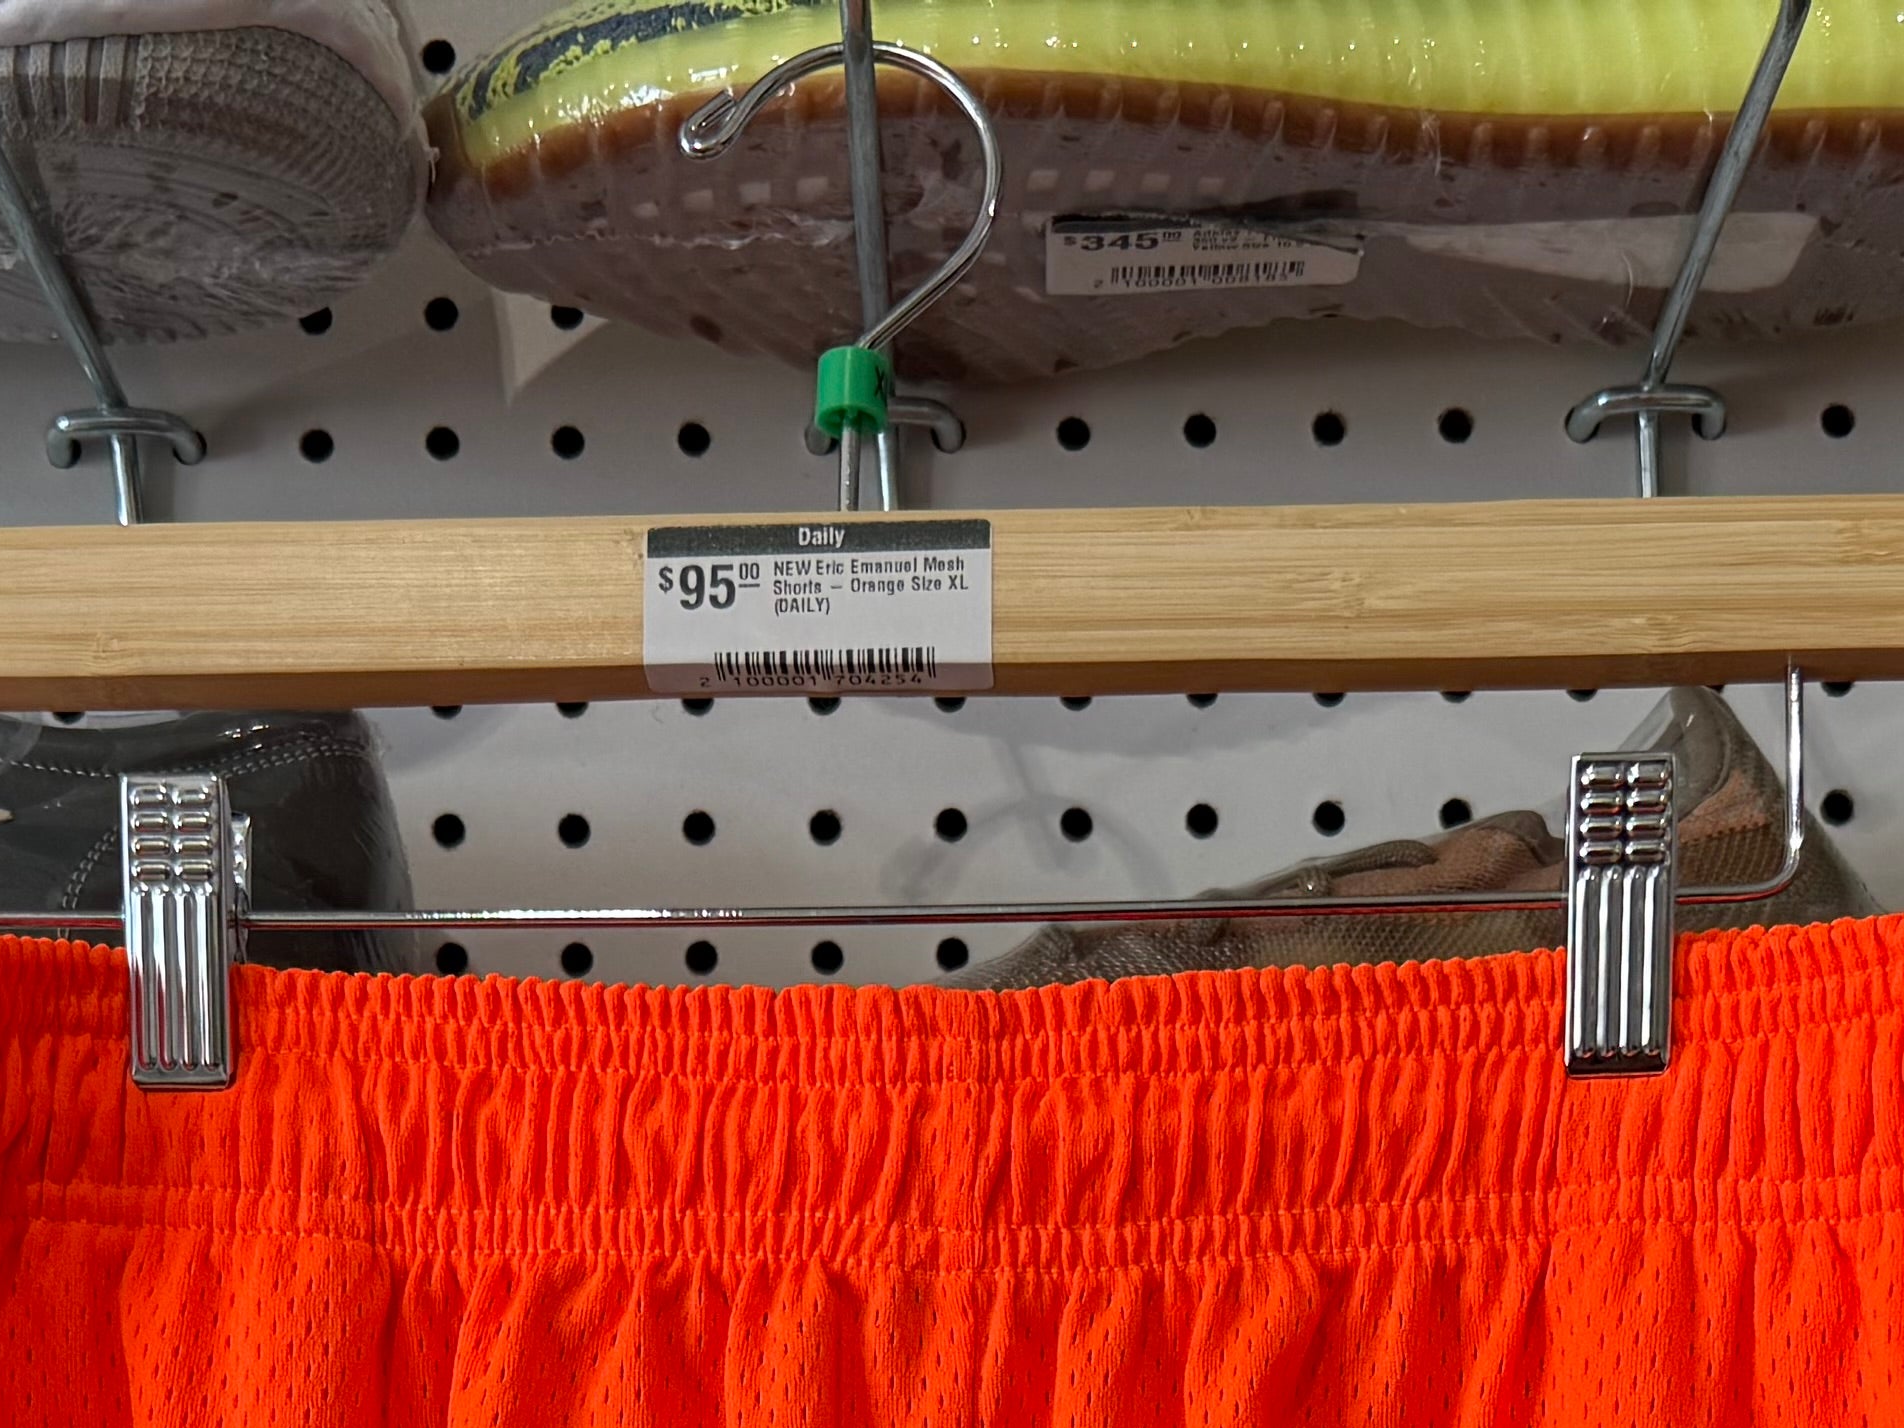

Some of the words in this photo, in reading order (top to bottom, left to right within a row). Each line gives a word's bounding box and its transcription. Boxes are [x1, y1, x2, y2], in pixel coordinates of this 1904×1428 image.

[798, 526, 845, 549] Daily
[773, 560, 812, 577] NEW
[816, 559, 845, 576] Eric
[851, 556, 917, 575] Emanuel
[923, 554, 965, 573] Mesh
[773, 579, 822, 596] Shorts
[851, 576, 905, 596] Orange
[911, 575, 942, 592] Size
[948, 573, 969, 591] XL
[774, 597, 831, 617] (DAILY)
[699, 676, 712, 688] 2
[734, 674, 817, 687] 100001
[835, 673, 924, 686] 704254
